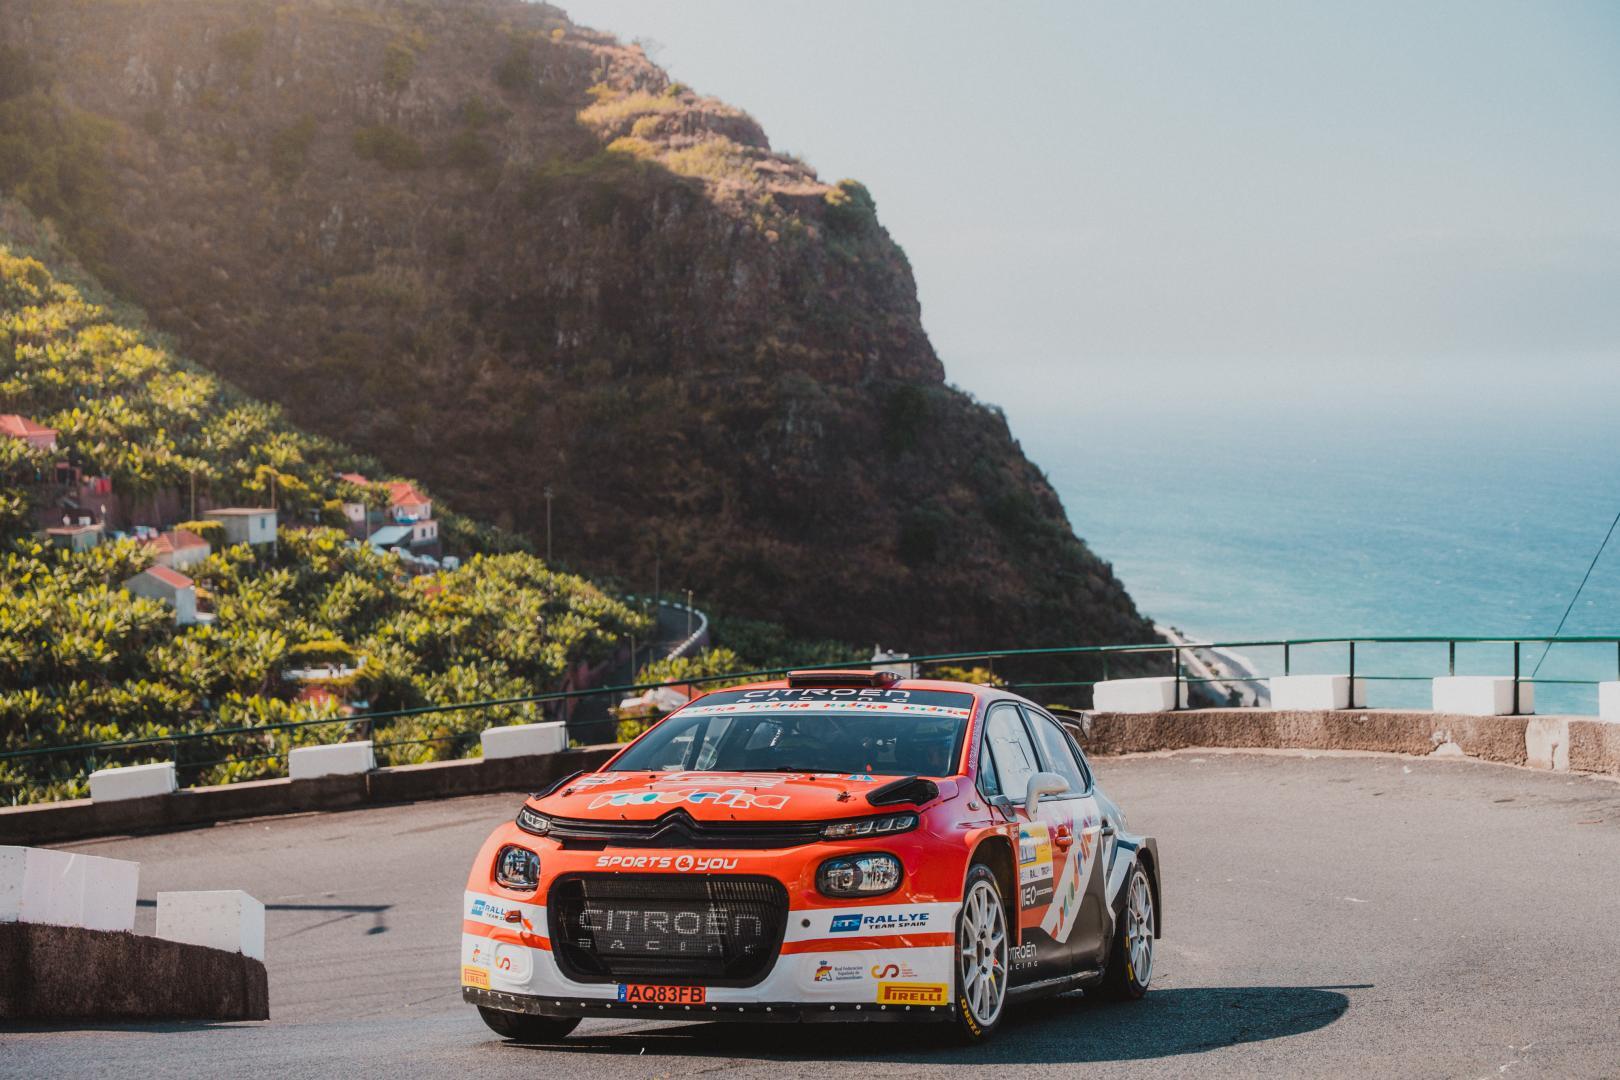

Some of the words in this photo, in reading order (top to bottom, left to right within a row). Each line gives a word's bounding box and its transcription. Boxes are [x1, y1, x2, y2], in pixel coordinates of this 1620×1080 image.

[595, 855, 671, 868] SPORTS
[695, 858, 739, 870] YOU
[832, 918, 861, 928] RTS
[863, 913, 929, 923] RALLYE
[628, 986, 703, 1003] AQ83FB
[884, 986, 942, 1001] PIRELLI
